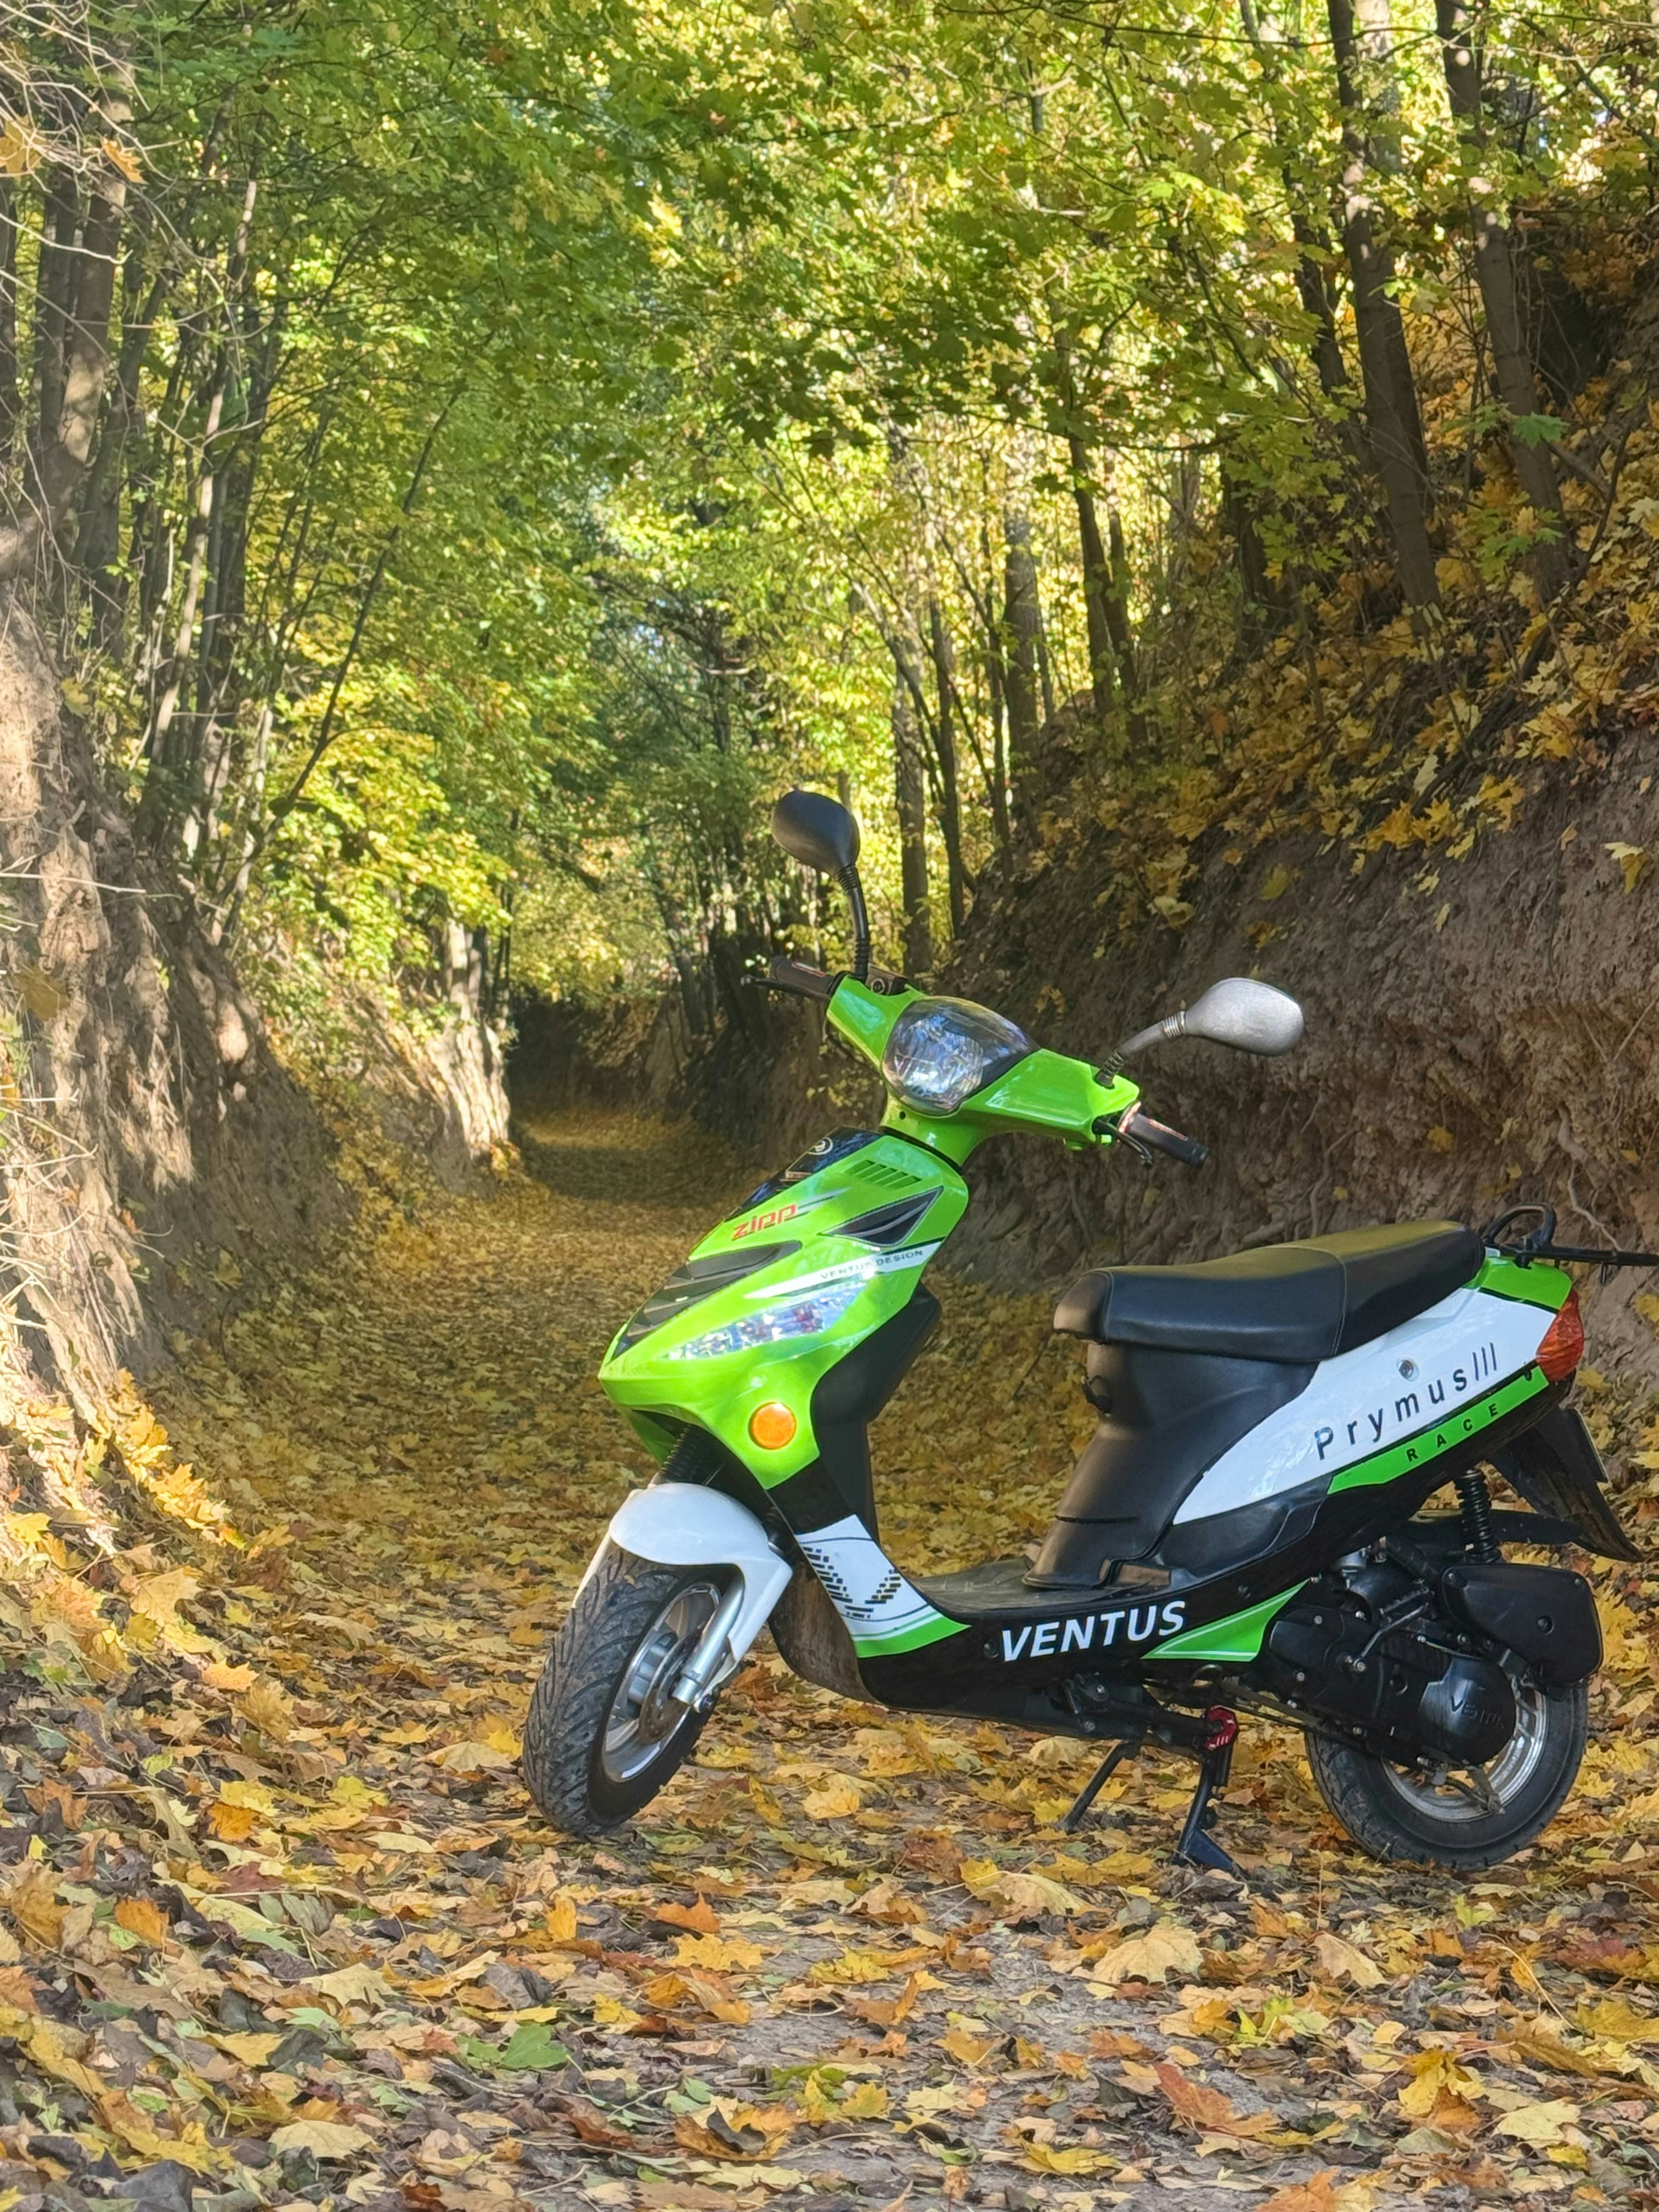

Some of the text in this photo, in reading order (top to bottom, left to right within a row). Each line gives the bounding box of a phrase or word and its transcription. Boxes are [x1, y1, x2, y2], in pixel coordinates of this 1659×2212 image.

[820, 1262, 873, 1279] VENTUS
[1406, 1403, 1498, 1462] RACE
[1002, 1601, 1186, 1662] VENTUS
